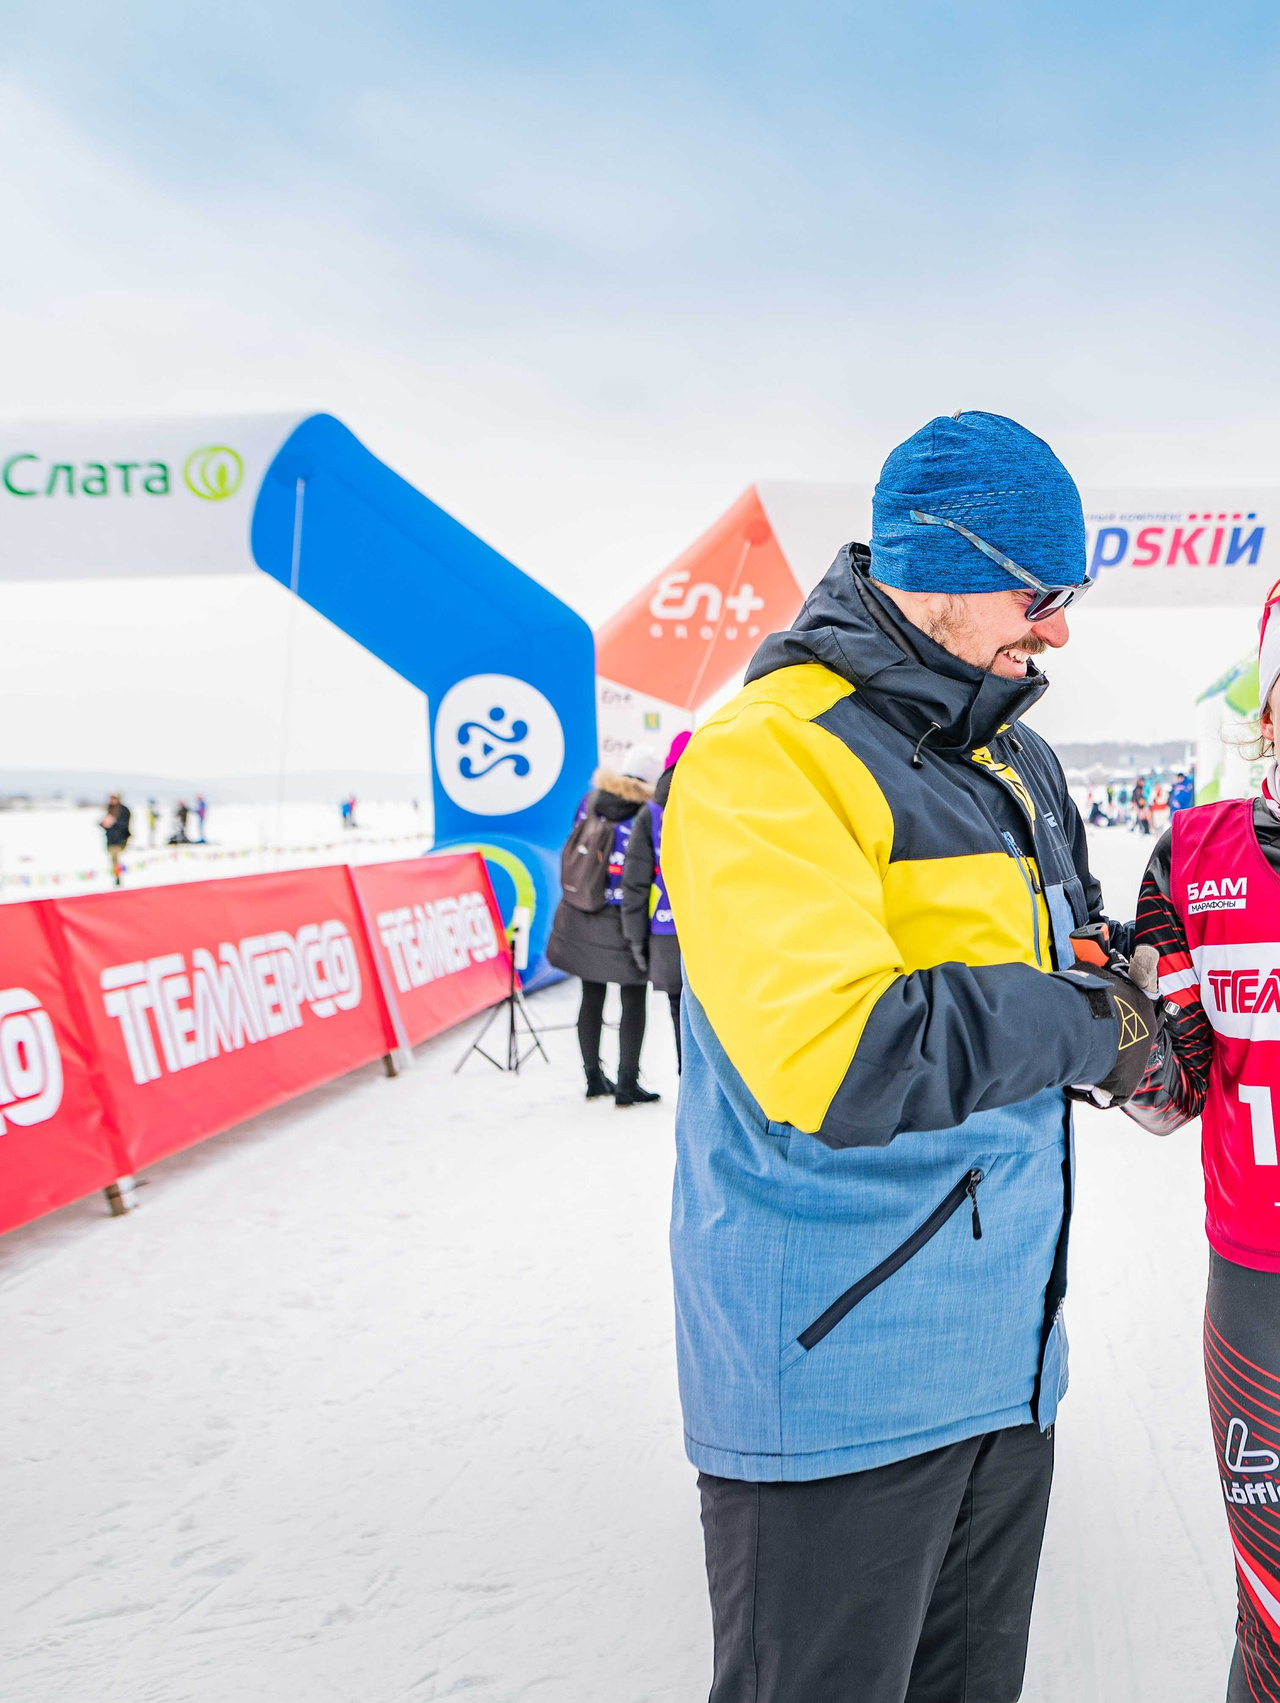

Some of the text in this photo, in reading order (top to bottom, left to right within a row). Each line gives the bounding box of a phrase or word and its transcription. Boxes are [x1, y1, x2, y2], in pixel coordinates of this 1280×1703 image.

[3, 454, 169, 496] Слата
[650, 623, 760, 640] GROUP
[1187, 877, 1247, 901] БАМ
[1191, 900, 1237, 912] МАРАФОНЫ
[376, 891, 499, 993] ТЕМЕРСО
[101, 918, 363, 1085] ТЕМЕРСО
